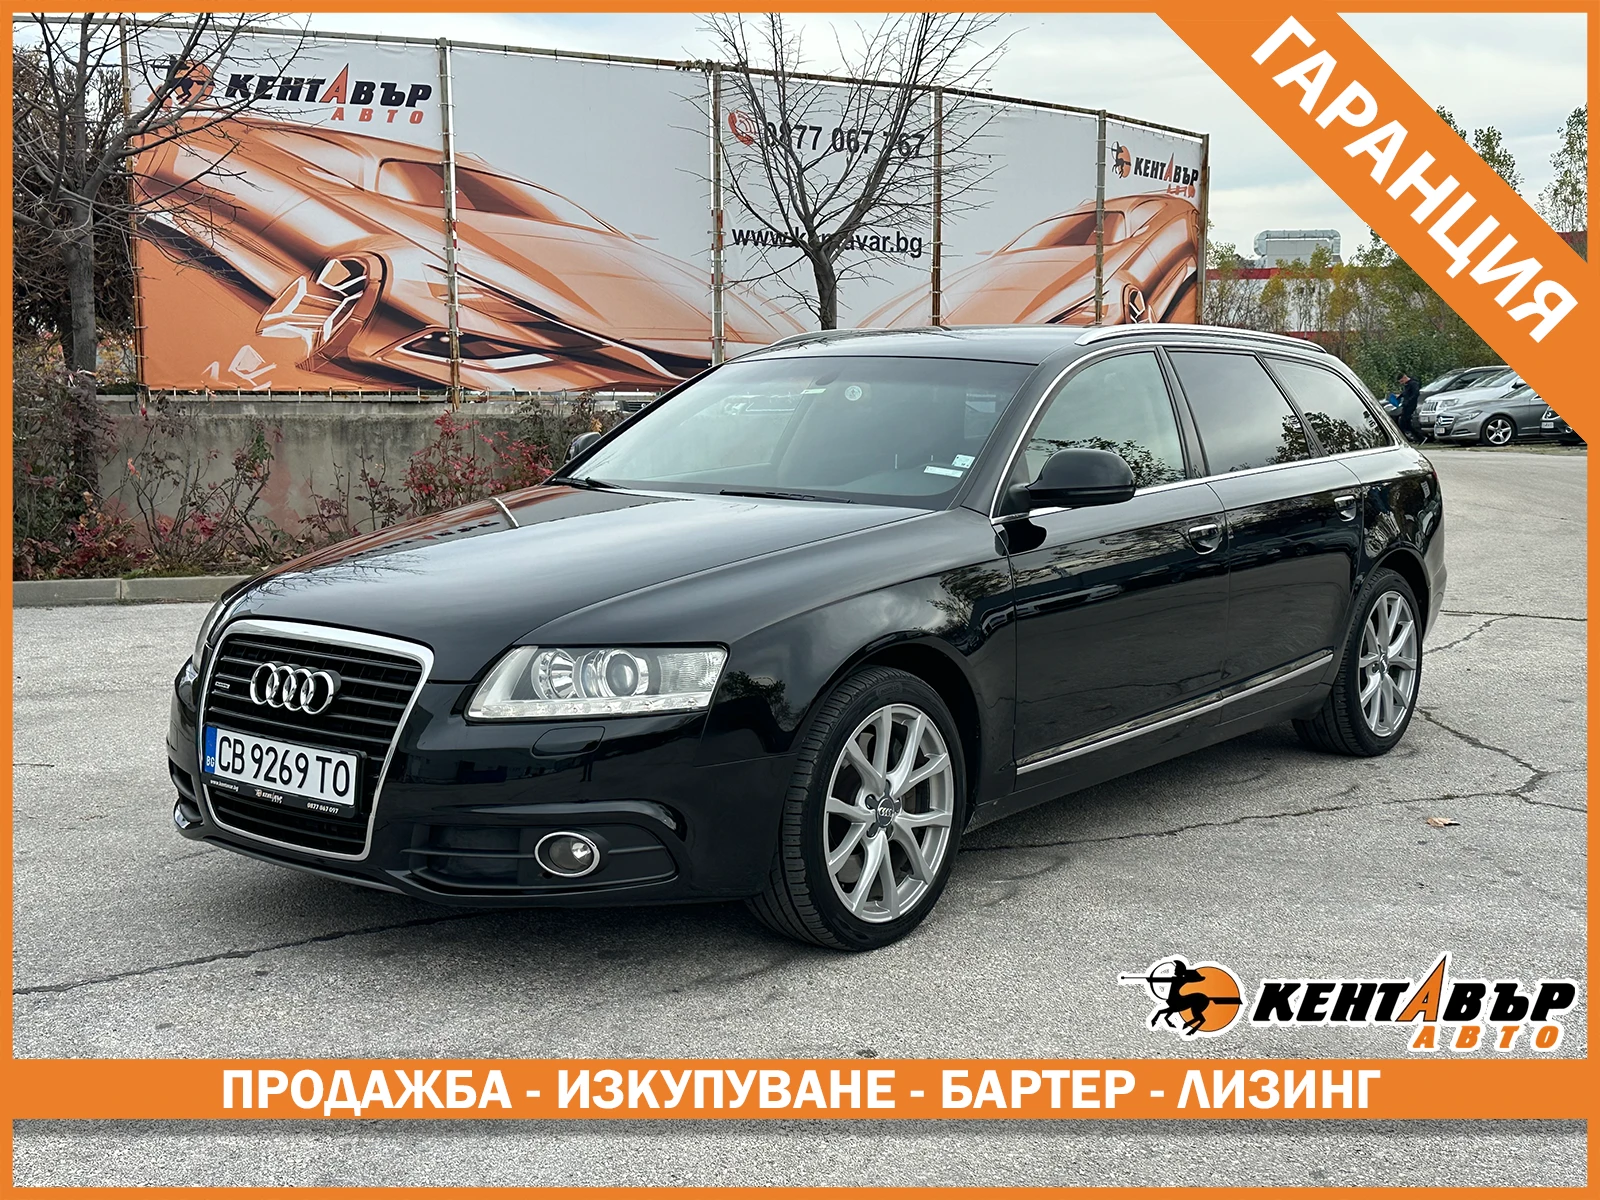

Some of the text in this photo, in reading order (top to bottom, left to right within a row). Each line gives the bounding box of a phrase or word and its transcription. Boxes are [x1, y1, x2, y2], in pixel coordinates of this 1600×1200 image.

[224, 63, 432, 108] КЕНТАВЪР
[331, 106, 424, 124] АВТО
[1134, 152, 1199, 186] КЕНТАВЪР
[206, 755, 215, 767] BG
[251, 743, 309, 789] 9269
